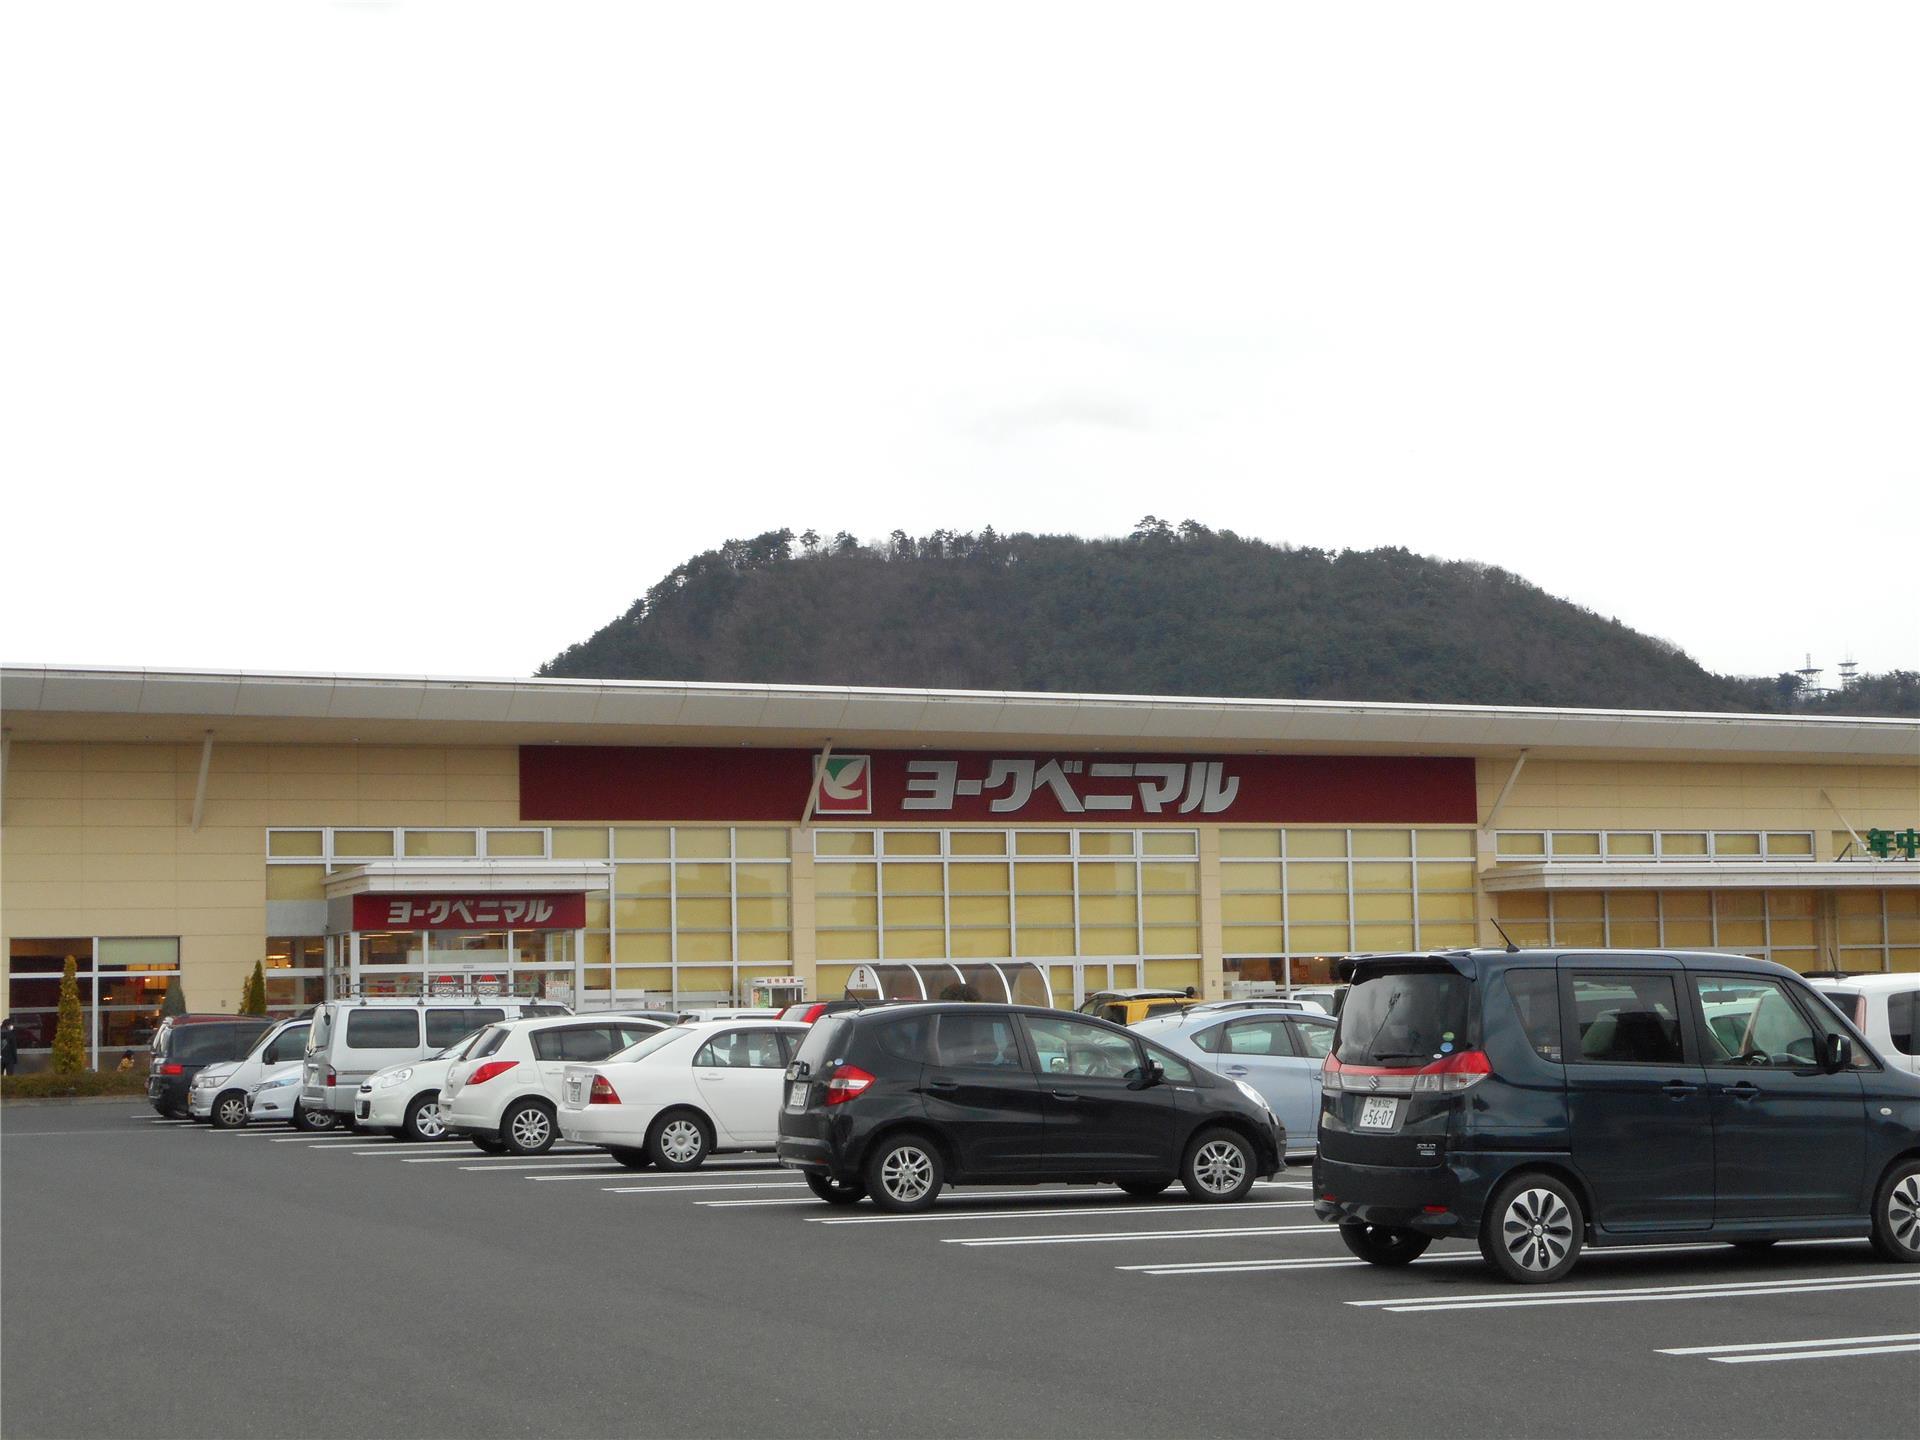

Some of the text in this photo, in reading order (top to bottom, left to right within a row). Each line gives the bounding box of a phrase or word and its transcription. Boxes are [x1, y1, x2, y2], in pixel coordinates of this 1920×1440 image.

[901, 758, 1240, 813] ヨークベニマル
[387, 900, 553, 924] ヨークベニマル
[1367, 1110, 1394, 1126] 56-07
